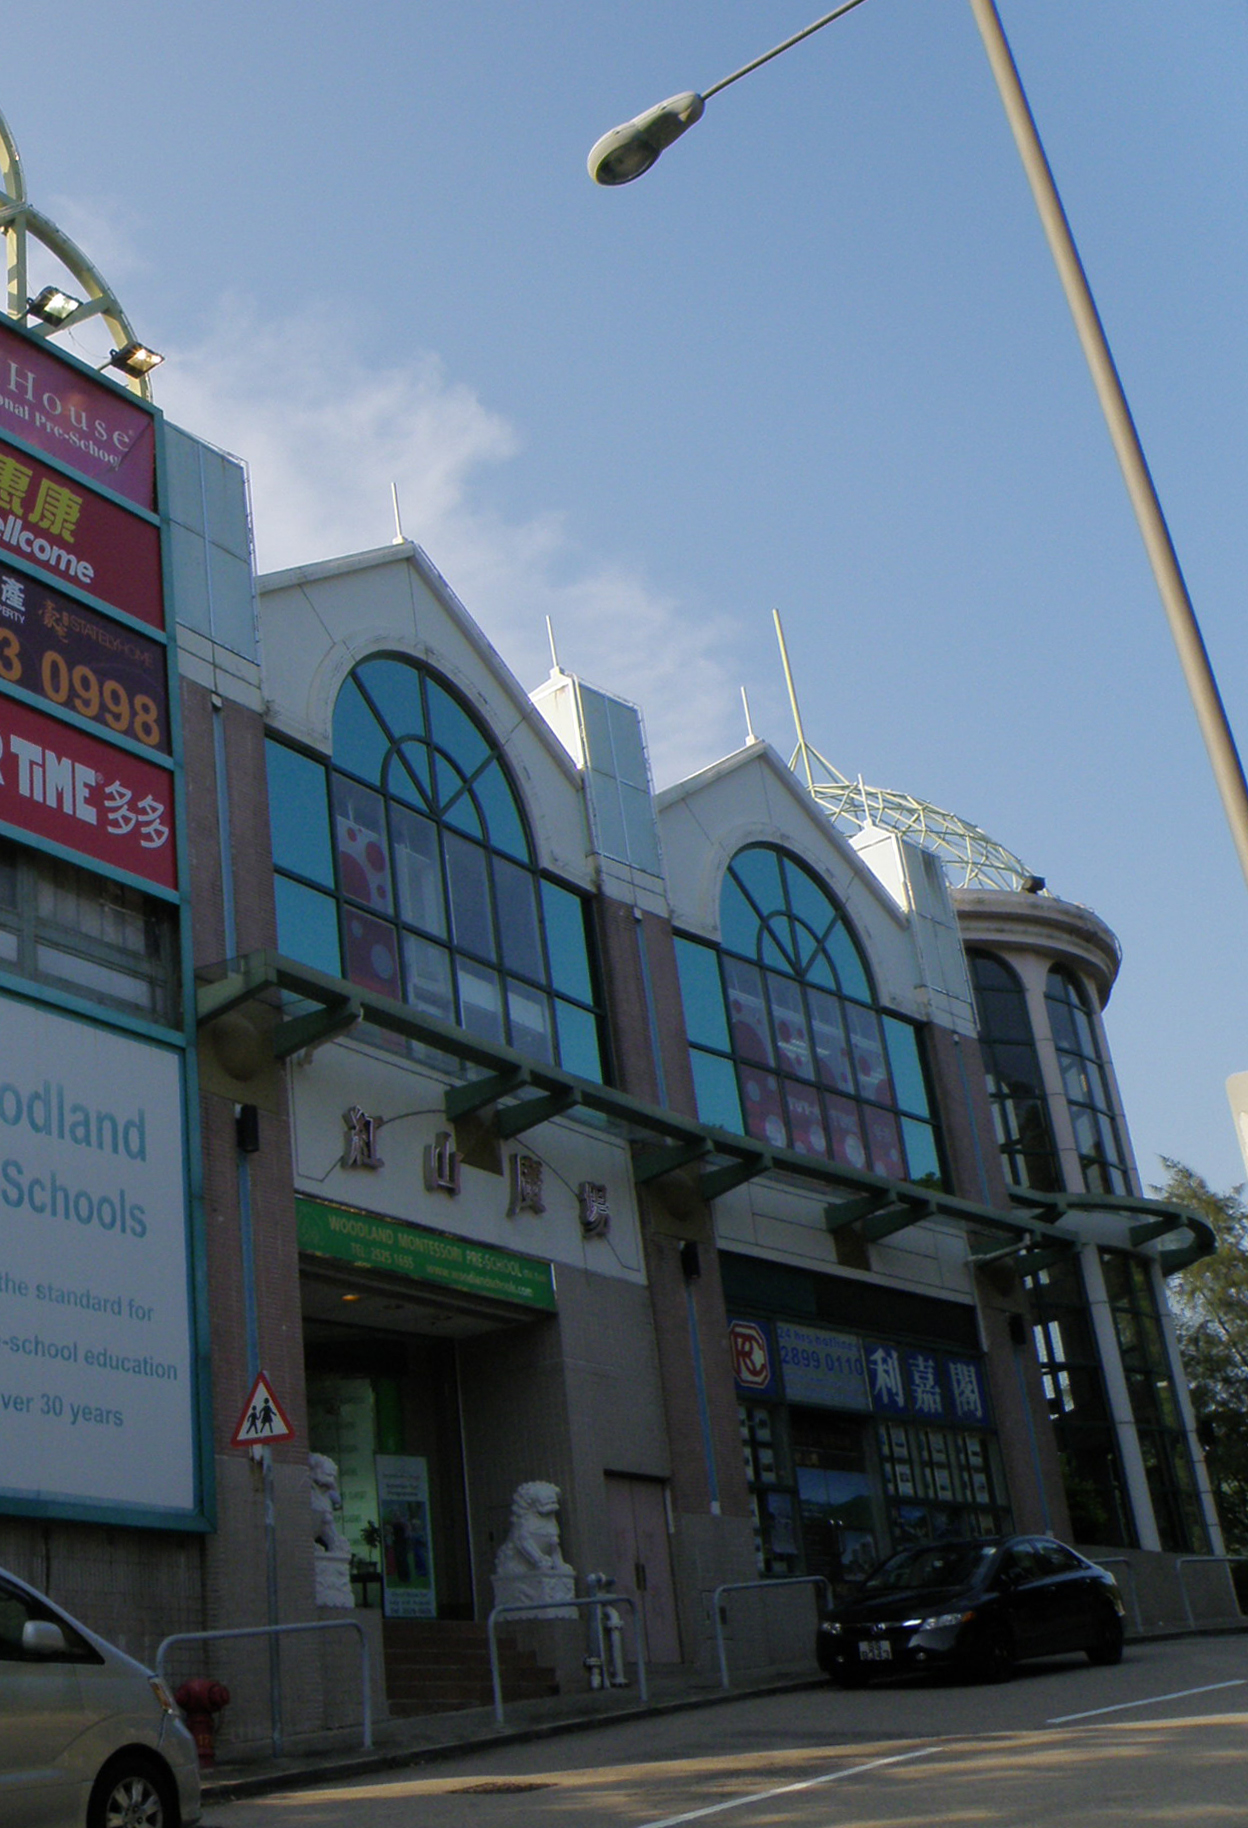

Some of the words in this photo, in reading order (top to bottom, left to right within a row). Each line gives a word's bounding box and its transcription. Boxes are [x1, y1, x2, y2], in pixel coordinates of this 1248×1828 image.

[41, 651, 161, 746] 0998
[10, 734, 97, 827] TIME
[104, 780, 169, 848] 多多
[328, 1215, 394, 1244] WOODLAND
[398, 1232, 462, 1262] MONTESSORI
[466, 1250, 522, 1277] PRE-SCHOOL
[36, 1281, 122, 1317] standard
[128, 1297, 154, 1322] for
[84, 1348, 178, 1382] education
[779, 1345, 821, 1369] 2899
[824, 1353, 865, 1377] 0110
[869, 1347, 983, 1419] 利嘉閣
[40, 1393, 64, 1417] 30
[70, 1401, 125, 1428] years
